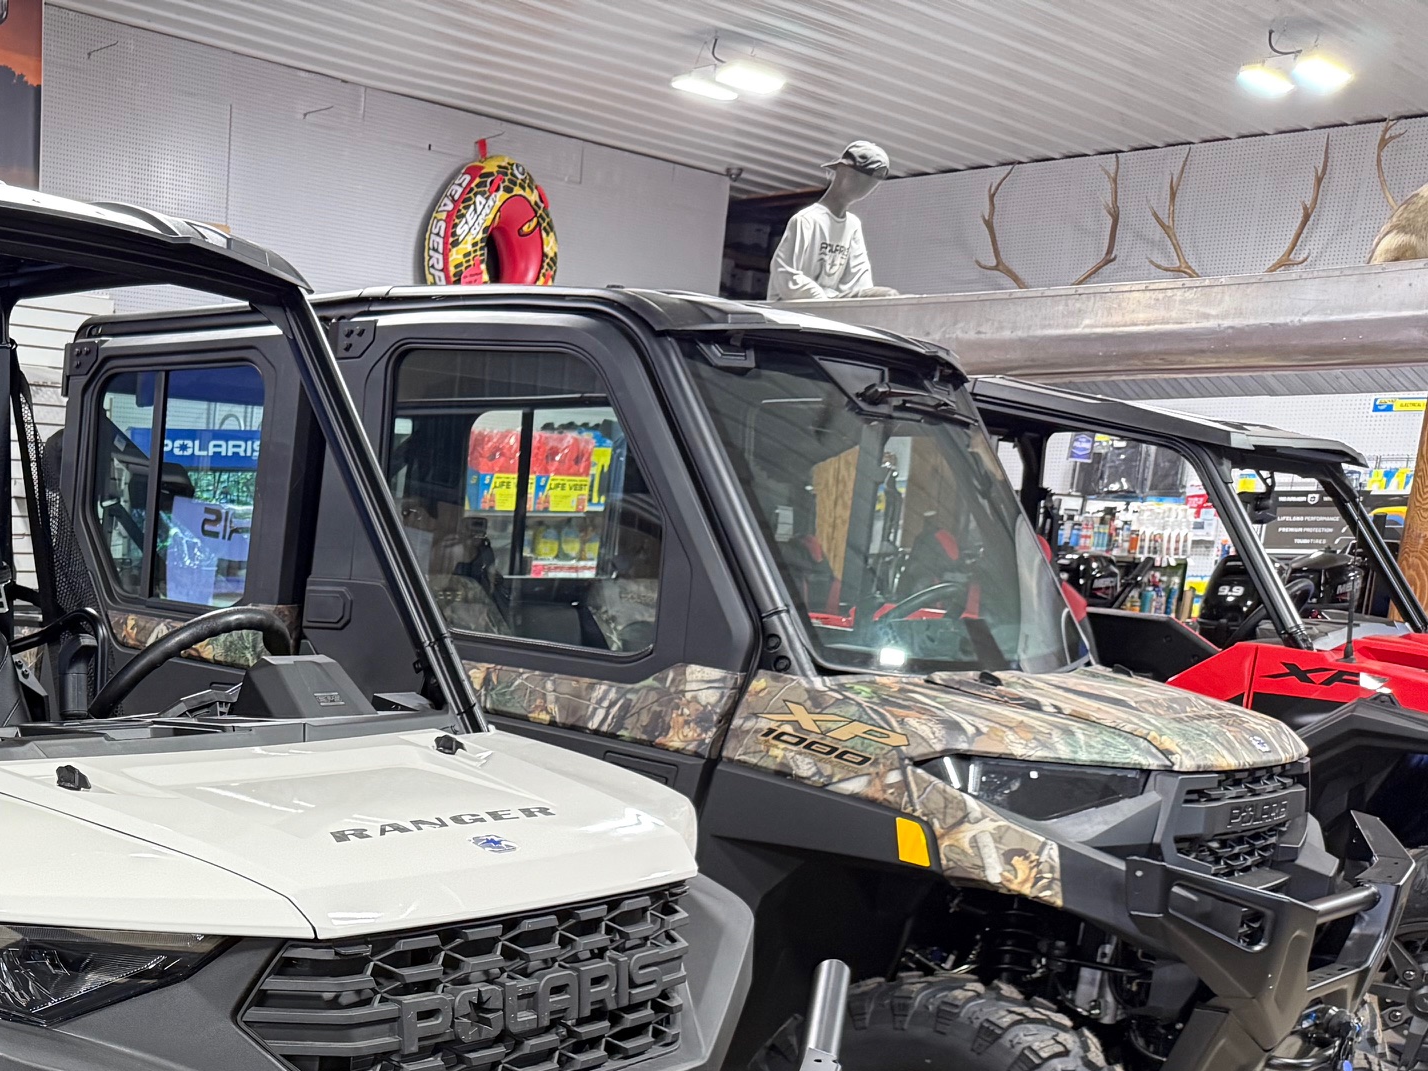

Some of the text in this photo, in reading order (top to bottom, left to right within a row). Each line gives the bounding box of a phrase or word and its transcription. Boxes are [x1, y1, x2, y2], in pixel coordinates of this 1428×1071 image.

[438, 174, 471, 212] SEA
[456, 194, 487, 242] SEA
[1218, 585, 1245, 596] 9.9
[752, 699, 910, 747] XP
[760, 727, 873, 767] 1000
[329, 806, 556, 843] RANGER
[397, 949, 664, 1055] POLARIS
